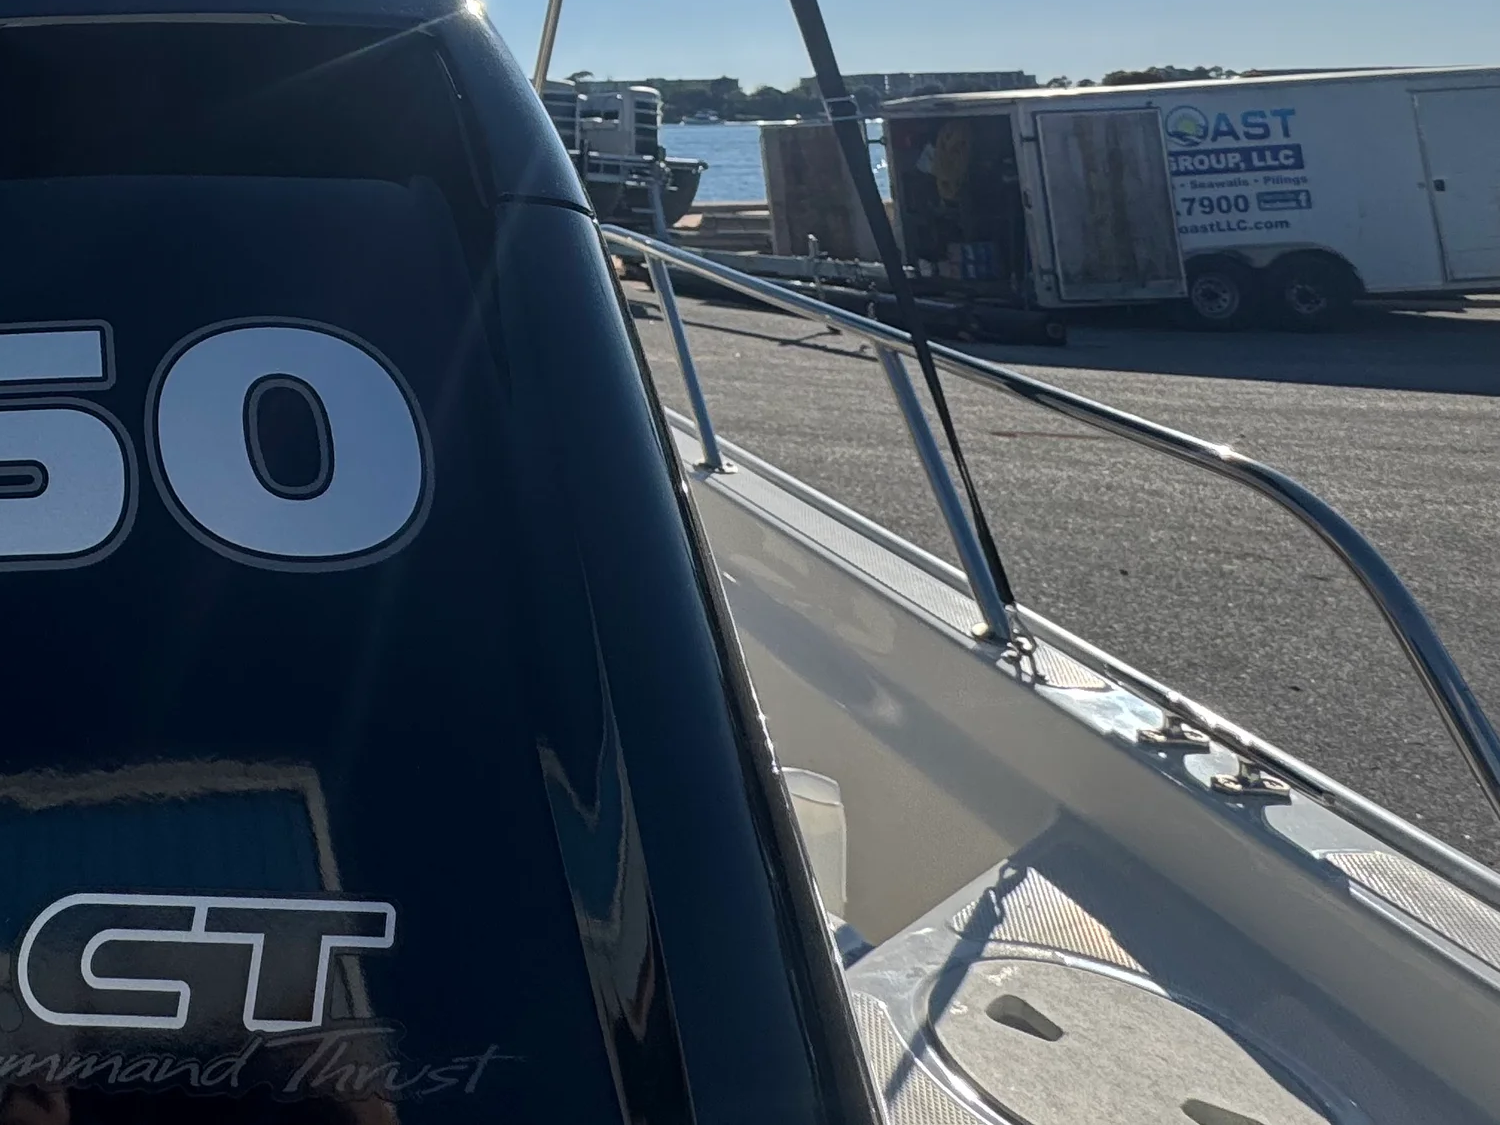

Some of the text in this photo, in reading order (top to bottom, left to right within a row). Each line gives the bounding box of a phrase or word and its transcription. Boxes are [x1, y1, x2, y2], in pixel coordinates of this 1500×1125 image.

[1251, 149, 1296, 168] LLC
[1190, 177, 1250, 190] Seawalls
[1263, 175, 1309, 186] Pilings
[17, 892, 396, 1033] CT
[267, 1026, 528, 1094] Thrust
